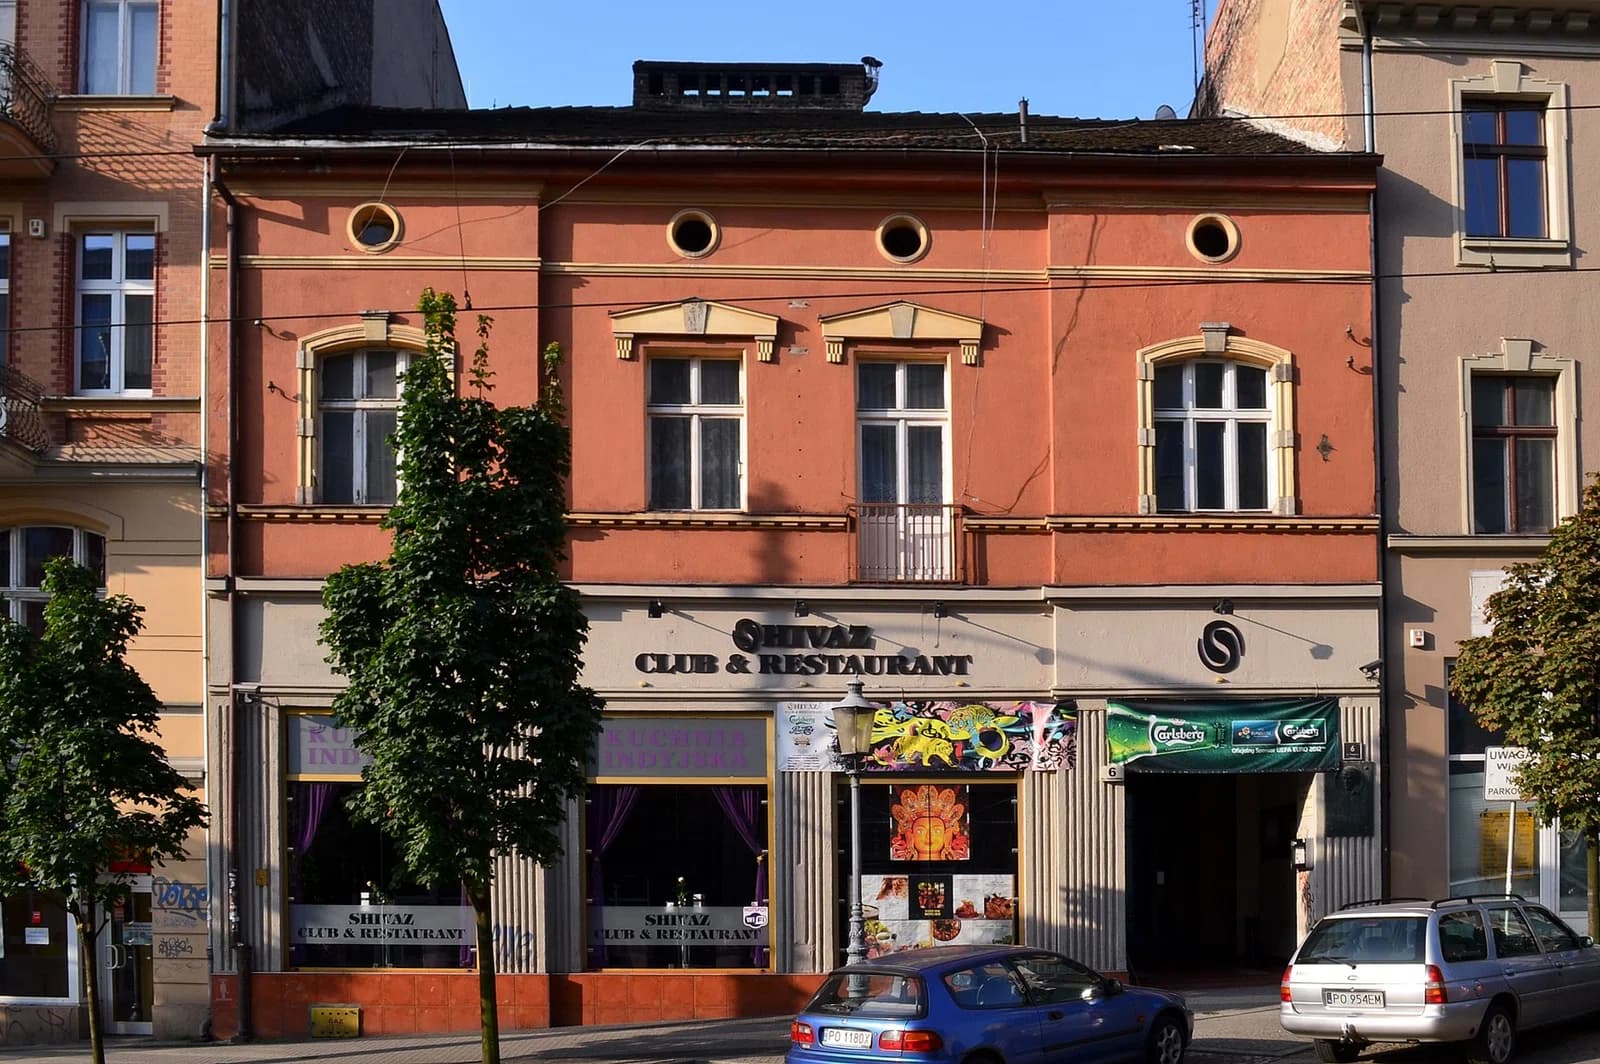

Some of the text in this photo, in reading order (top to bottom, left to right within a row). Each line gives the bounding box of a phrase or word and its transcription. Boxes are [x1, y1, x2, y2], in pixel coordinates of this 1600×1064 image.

[732, 618, 876, 653] SHIVAZ
[635, 653, 973, 675] CLUB & RESTAURANT
[606, 728, 747, 746] KUCHNIA
[1154, 725, 1204, 746] Carlsberg
[1283, 724, 1319, 740] Carlsberg
[606, 751, 748, 768] INDYJSKA
[1108, 767, 1117, 777] 6
[349, 913, 415, 925] SHIVAZ
[644, 914, 711, 926] SHIVAZ
[297, 928, 466, 939] CLUB & RESTAURANT
[594, 929, 762, 940] CLUB & RESTAURANT
[1333, 993, 1347, 1004] PO
[829, 1031, 841, 1042] PO
